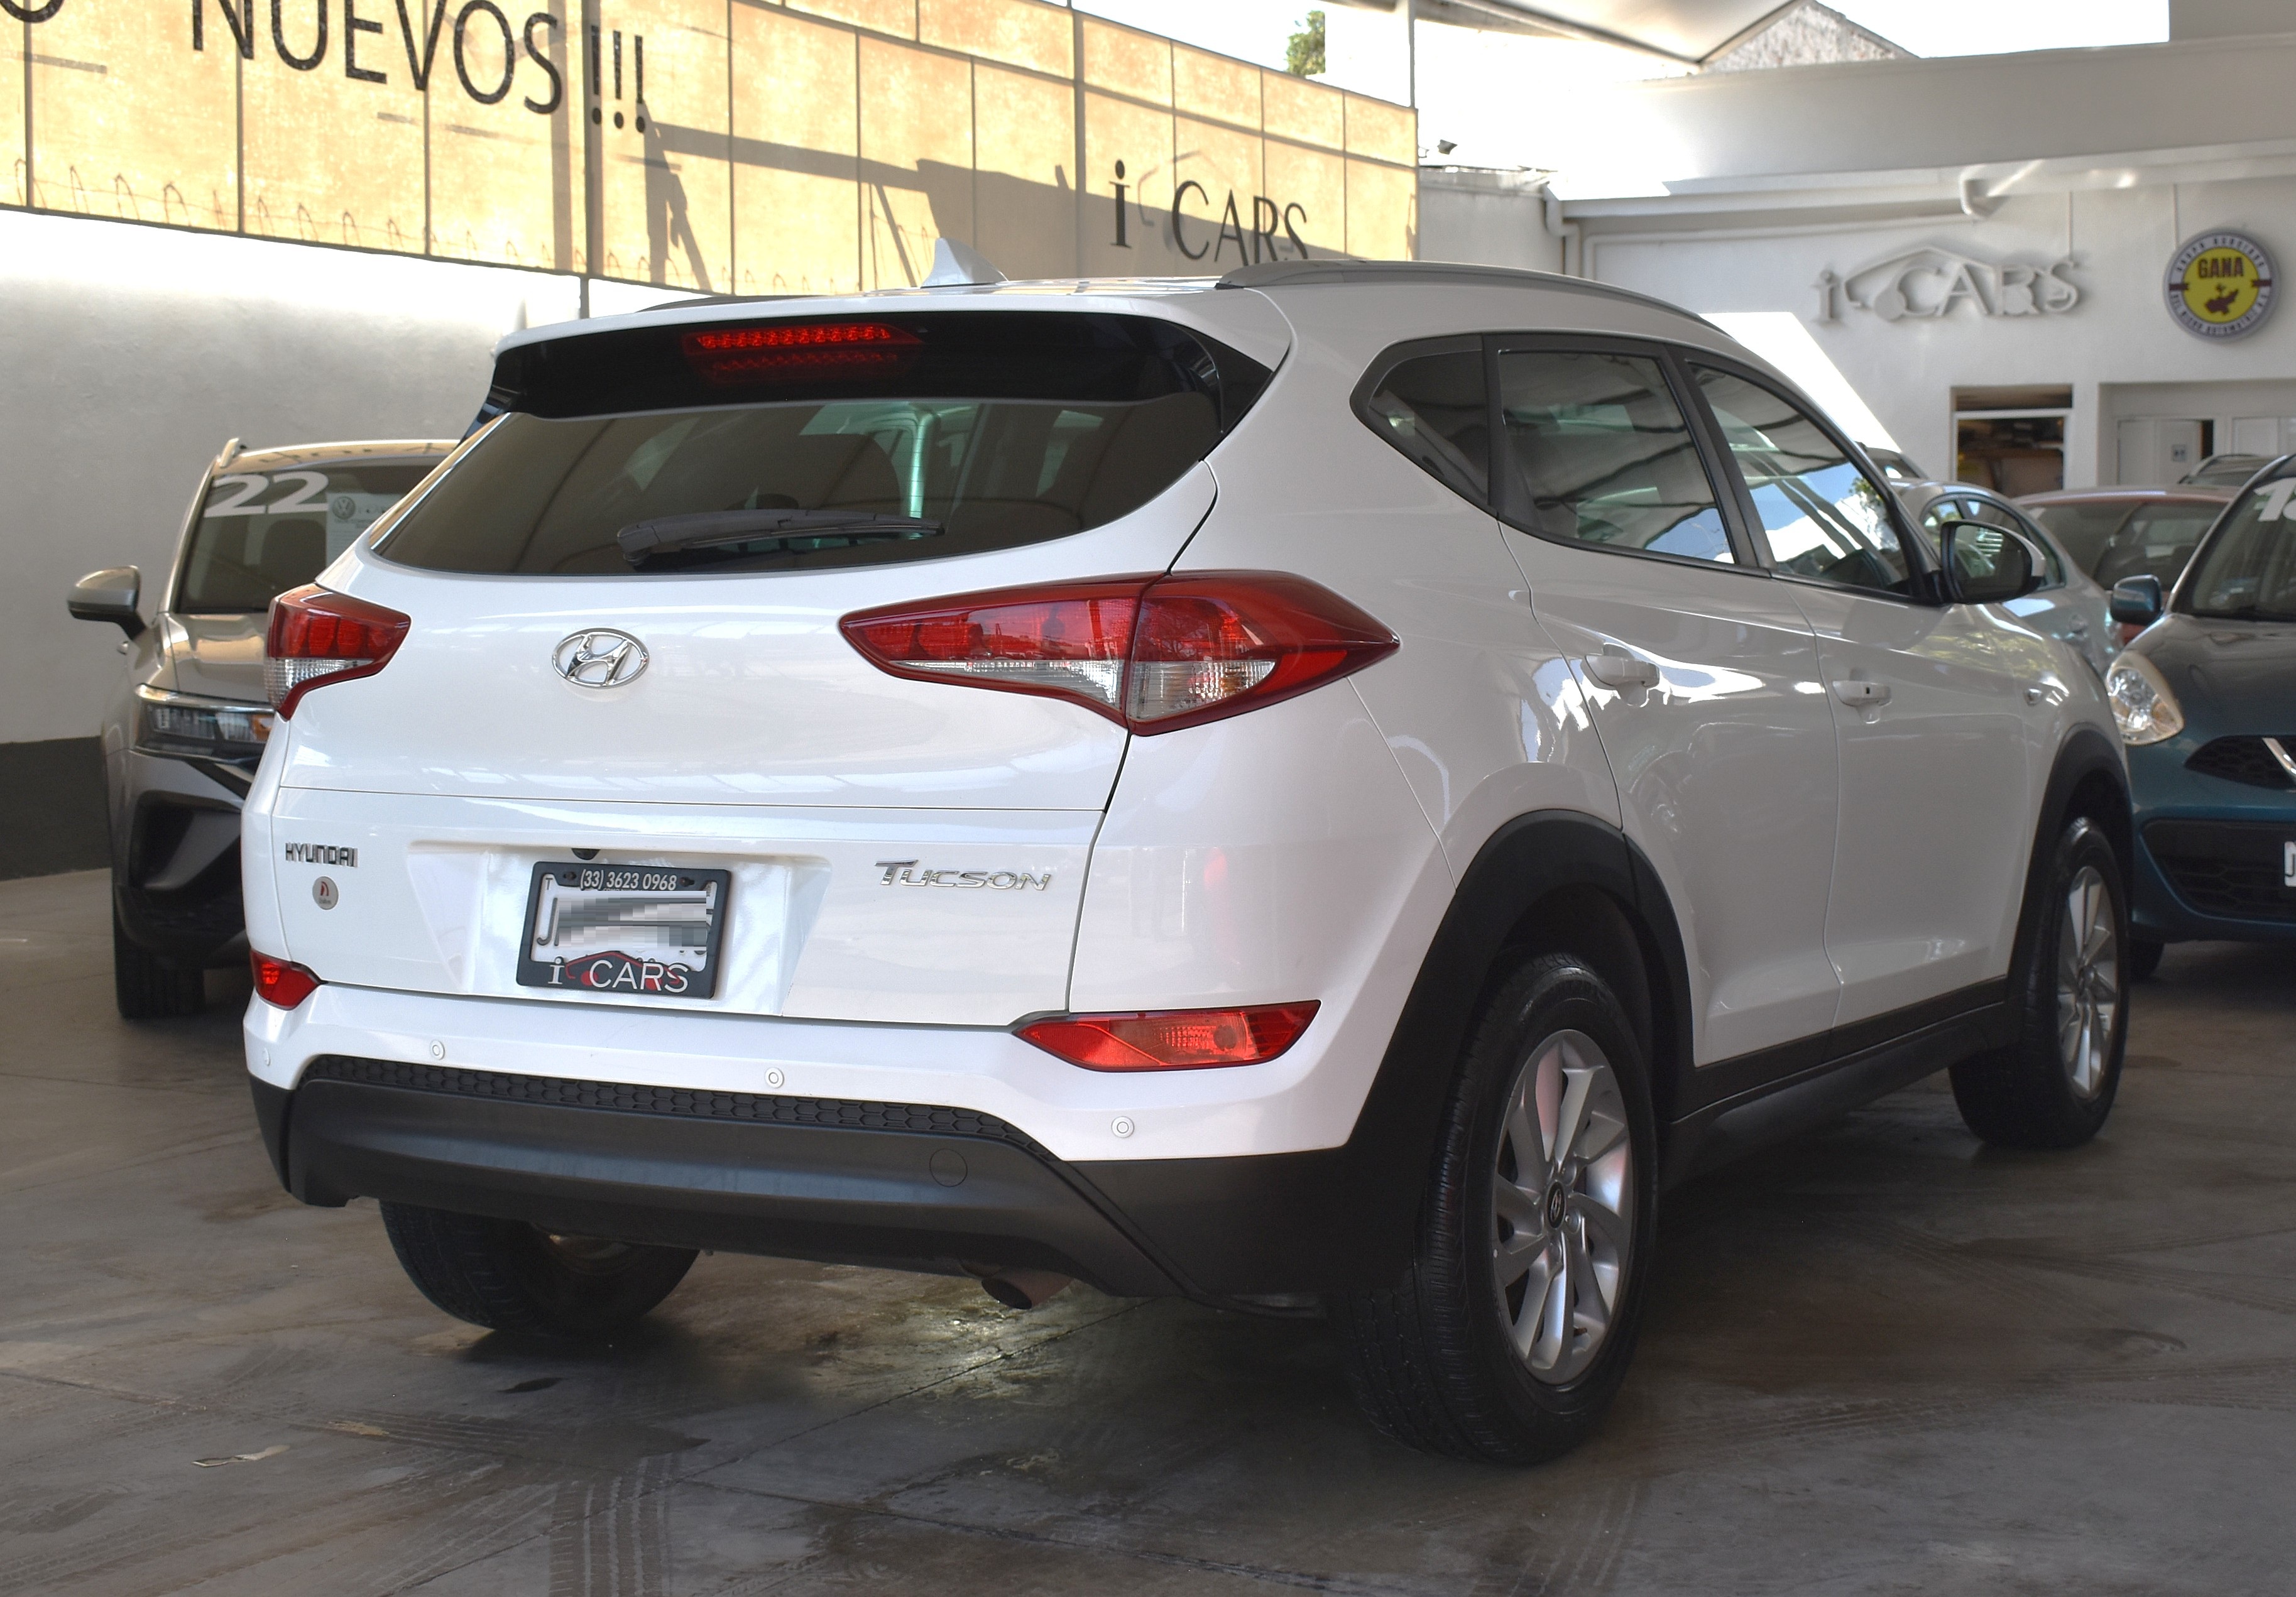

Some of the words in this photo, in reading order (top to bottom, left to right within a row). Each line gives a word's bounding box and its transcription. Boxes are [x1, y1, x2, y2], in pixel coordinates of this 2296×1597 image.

[1172, 180, 1308, 266] CARS
[2198, 257, 2244, 279] GANA
[1893, 261, 2081, 317] CARS
[204, 471, 329, 518] 22
[285, 842, 358, 868] HYUNDAI
[580, 869, 604, 890] (33)
[606, 871, 640, 889] 3623
[642, 873, 677, 891] 0968
[874, 859, 1051, 890] TUCSON
[589, 959, 689, 993] CARS
